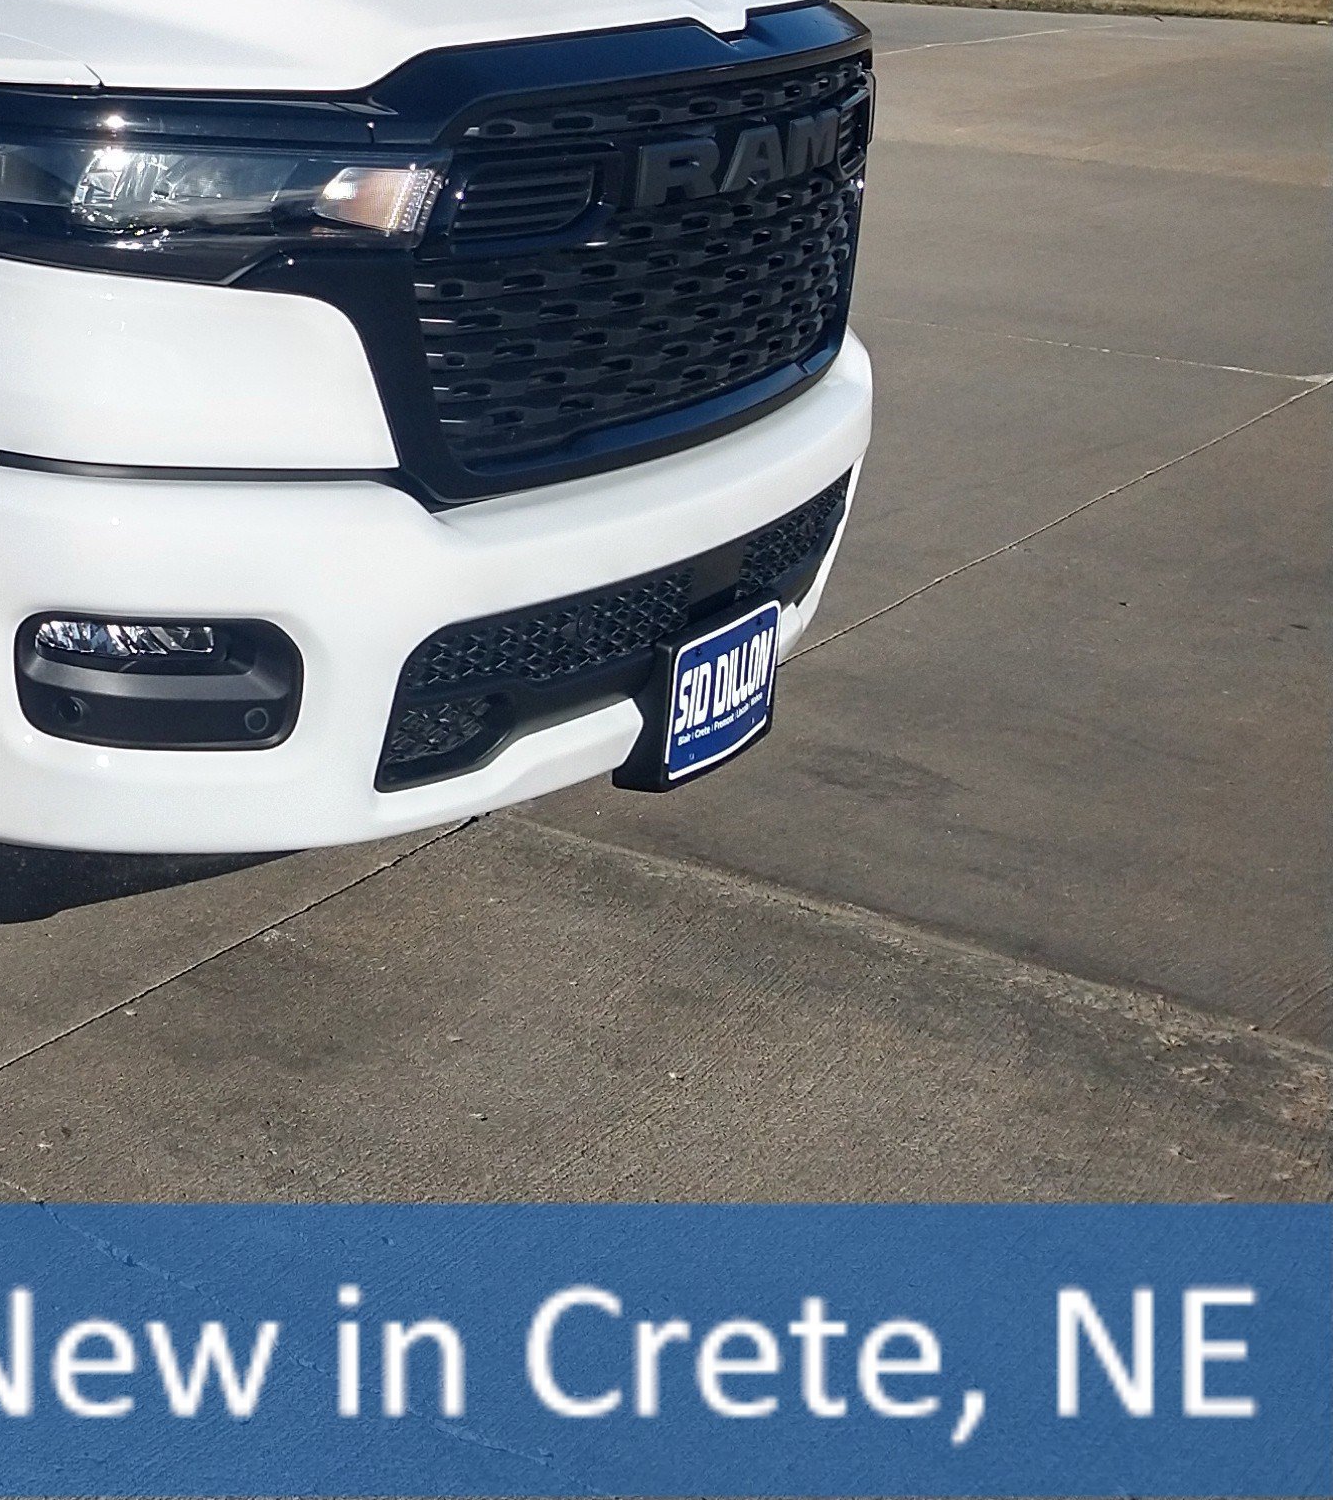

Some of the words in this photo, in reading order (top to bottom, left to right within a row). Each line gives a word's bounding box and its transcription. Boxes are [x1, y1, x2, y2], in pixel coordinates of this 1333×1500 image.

[635, 107, 841, 207] RAM
[674, 662, 712, 735] SID
[713, 627, 775, 717] DILLON
[694, 726, 711, 739] Crete
[714, 713, 735, 731] Fremont
